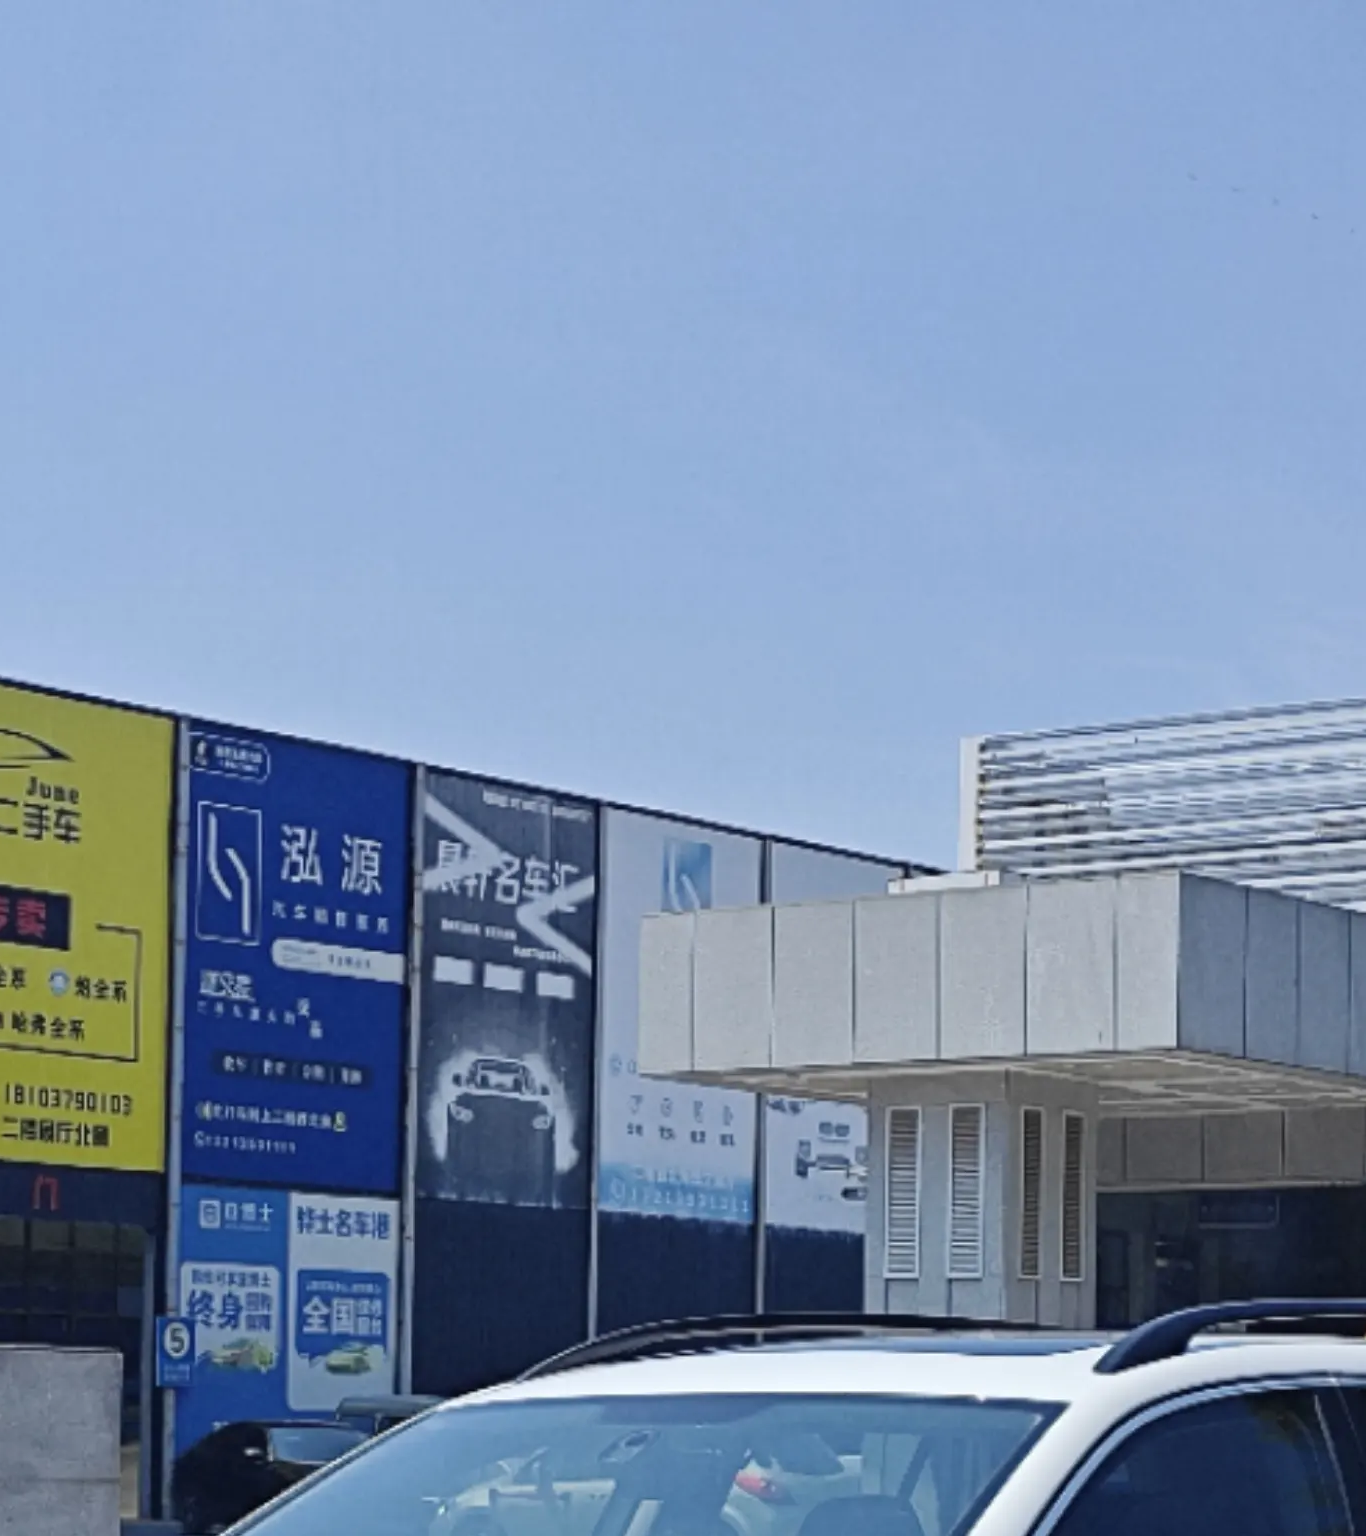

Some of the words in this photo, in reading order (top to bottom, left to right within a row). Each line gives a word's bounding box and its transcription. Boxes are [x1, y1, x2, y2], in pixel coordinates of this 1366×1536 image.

[26, 776, 81, 805] June
[280, 823, 383, 896] 泓源
[11, 1010, 86, 1041] 哈弗全系
[4, 1081, 133, 1115] 18103790103
[302, 1295, 355, 1336] 全国
[170, 1327, 185, 1354] 5
